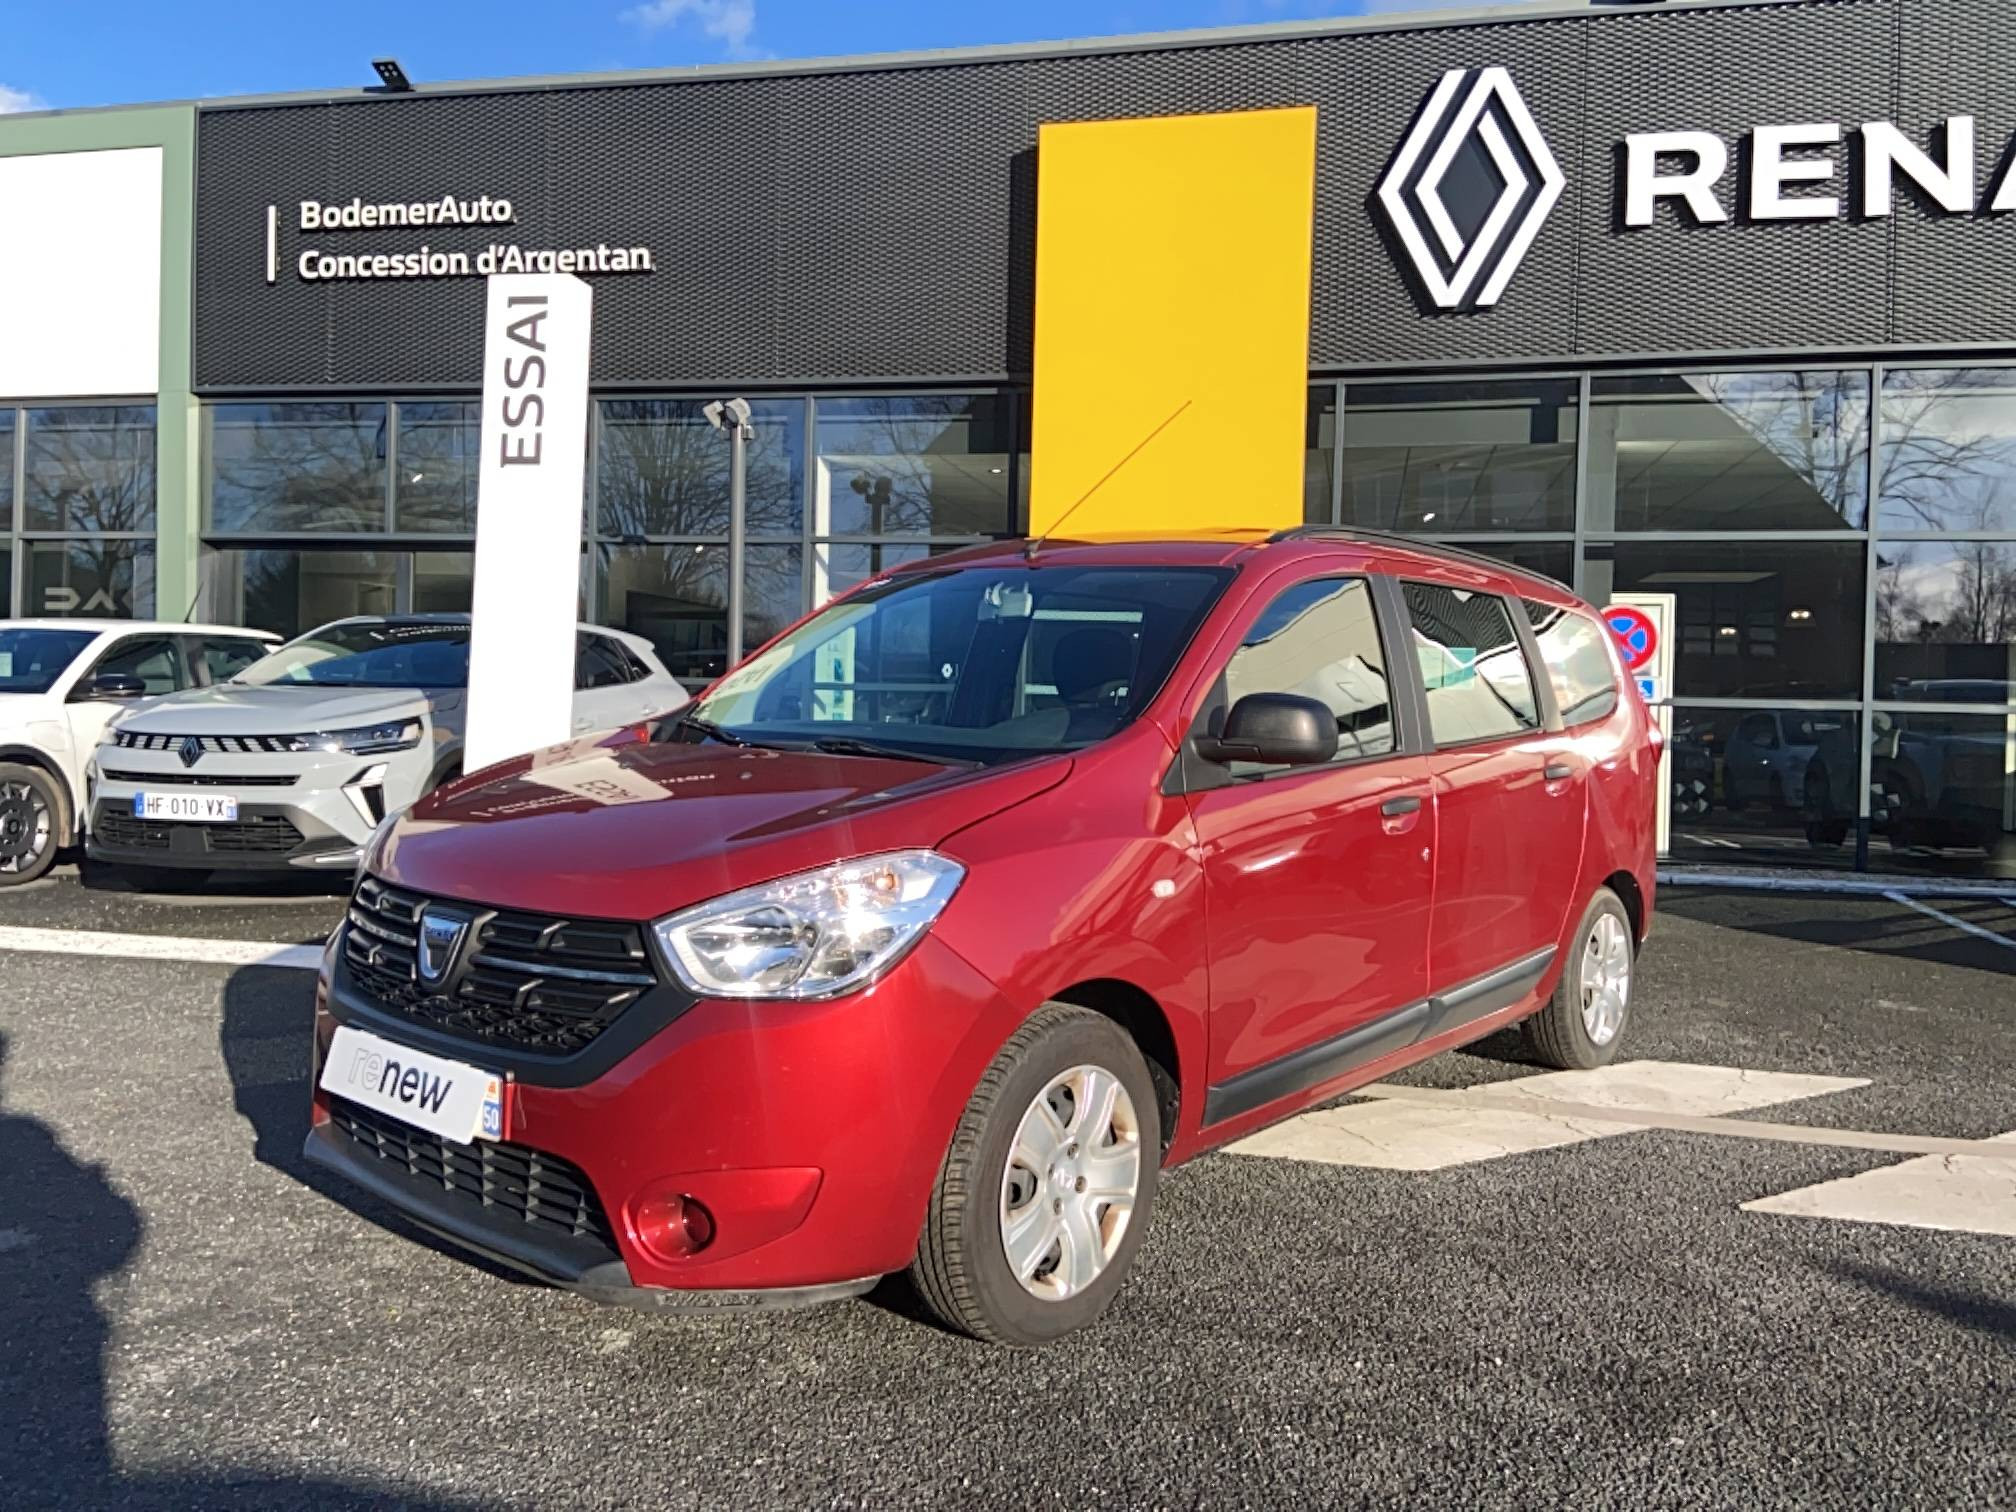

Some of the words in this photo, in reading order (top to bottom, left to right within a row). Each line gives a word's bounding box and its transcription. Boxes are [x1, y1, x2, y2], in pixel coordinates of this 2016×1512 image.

[1625, 115, 2016, 226] REN
[300, 195, 512, 230] BodemerAuto
[299, 247, 470, 279] Concession
[477, 243, 651, 275] d'Argentan
[501, 295, 549, 468] ESSAI
[347, 1047, 453, 1114] renew
[483, 1105, 499, 1131] 50
